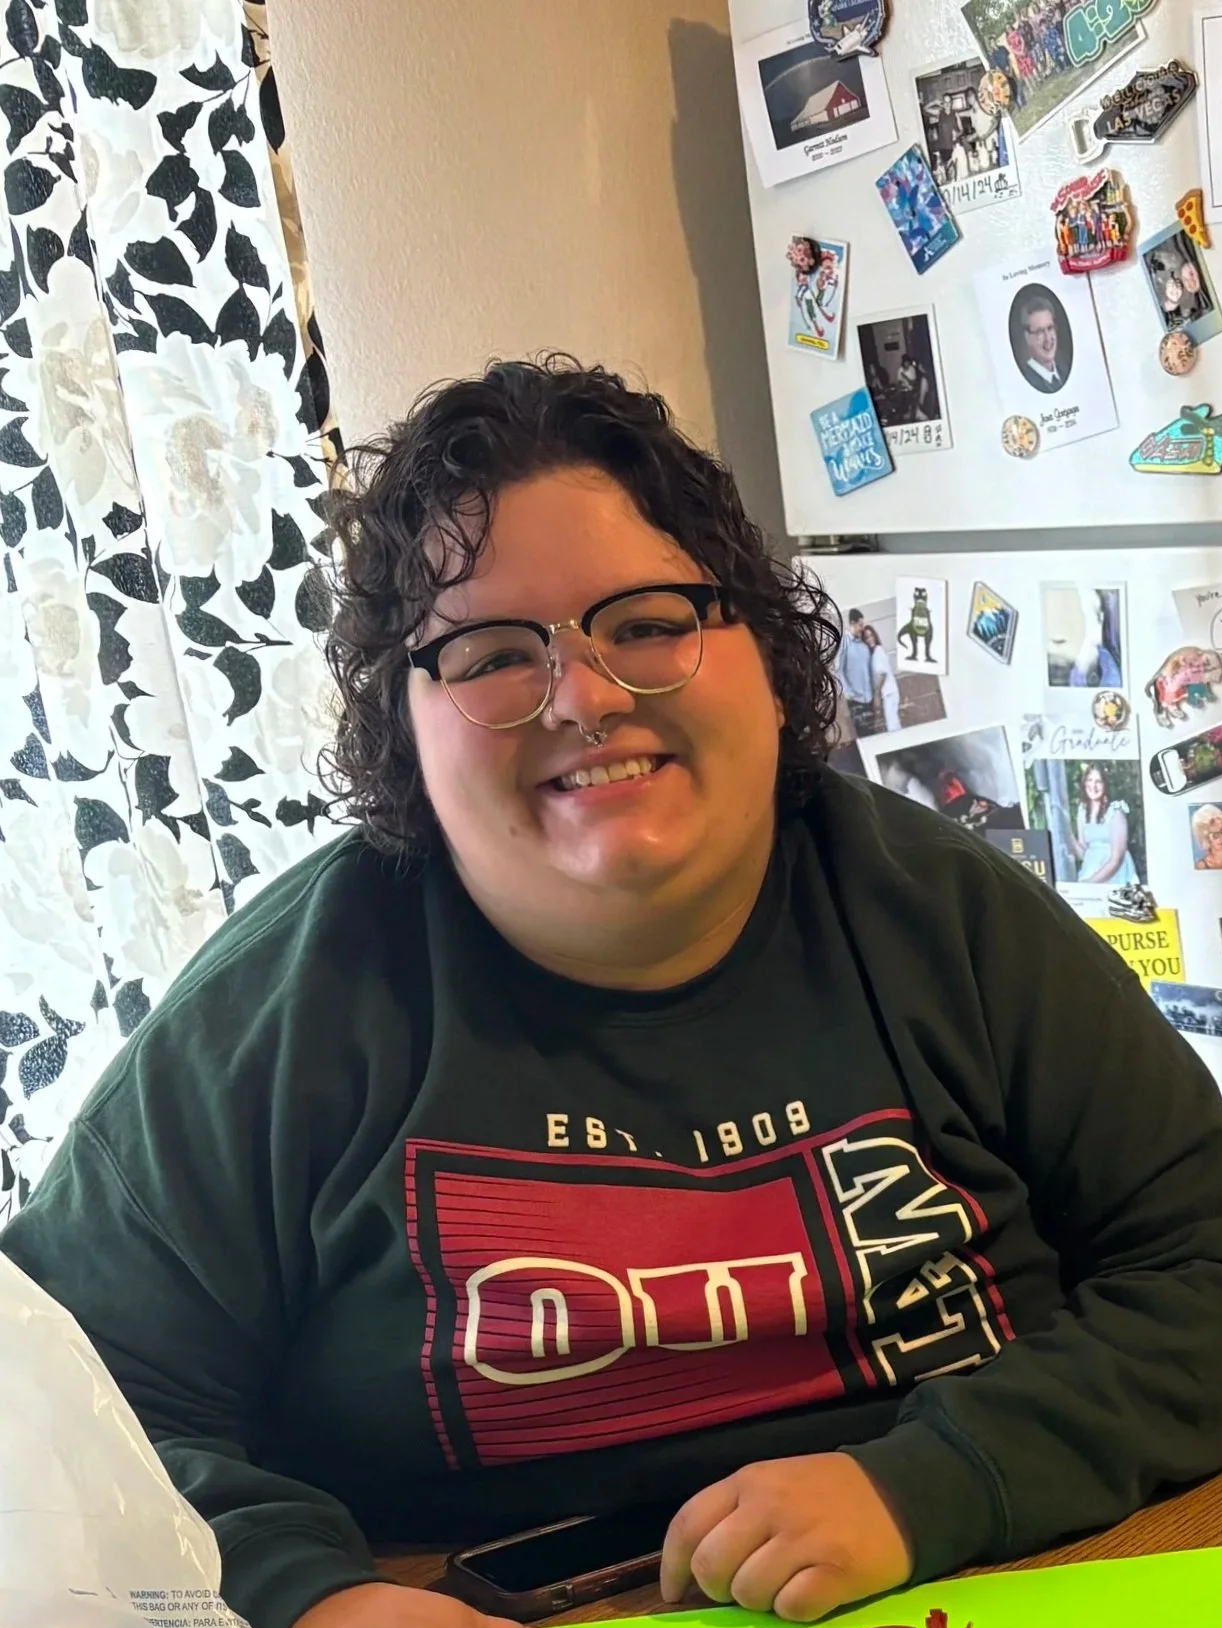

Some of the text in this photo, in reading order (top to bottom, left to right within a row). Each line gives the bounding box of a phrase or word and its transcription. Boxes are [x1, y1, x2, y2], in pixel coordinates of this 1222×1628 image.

[1134, 87, 1181, 119] VEGAS
[692, 1099, 811, 1164] 1909
[128, 1589, 212, 1600] WARNING: TO AVOID
[131, 1602, 149, 1611] THIS
[149, 1602, 166, 1611] BAG
[167, 1602, 181, 1611] OR
[182, 1602, 199, 1611] ANY
[201, 1601, 213, 1611] OF
[193, 1618, 217, 1627] PARA
